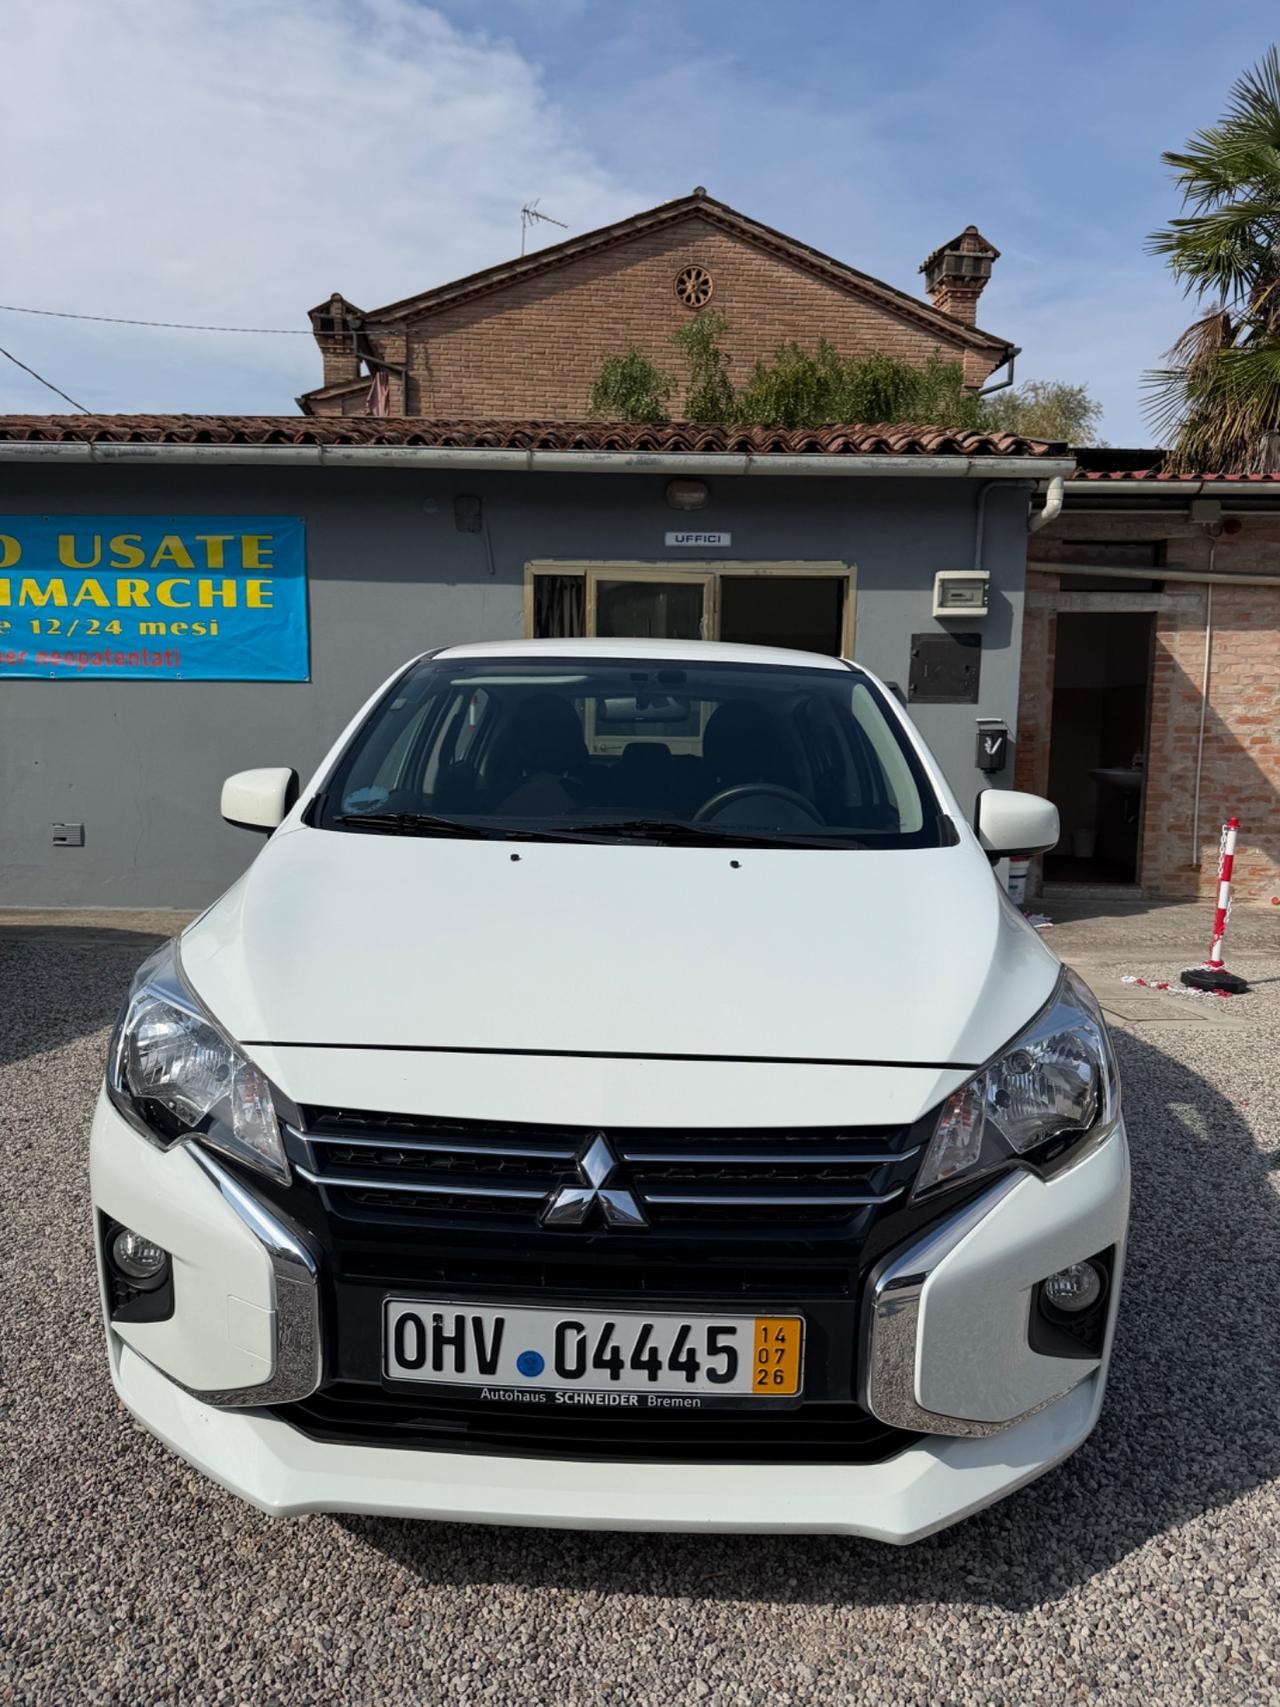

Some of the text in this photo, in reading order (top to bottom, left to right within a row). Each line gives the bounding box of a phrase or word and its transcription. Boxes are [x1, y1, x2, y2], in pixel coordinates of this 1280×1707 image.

[675, 535, 721, 543] UFFICI
[58, 534, 274, 569] USATE
[30, 618, 123, 637] 12/24
[138, 618, 219, 636] mesi
[0, 648, 181, 672] er neopatentati
[761, 1326, 786, 1344] 14
[394, 1312, 739, 1385] OHV 04445
[758, 1347, 785, 1365] 07
[756, 1368, 785, 1386] 26
[480, 1387, 702, 1408] Autohaus SCHNEIDER Bremen
